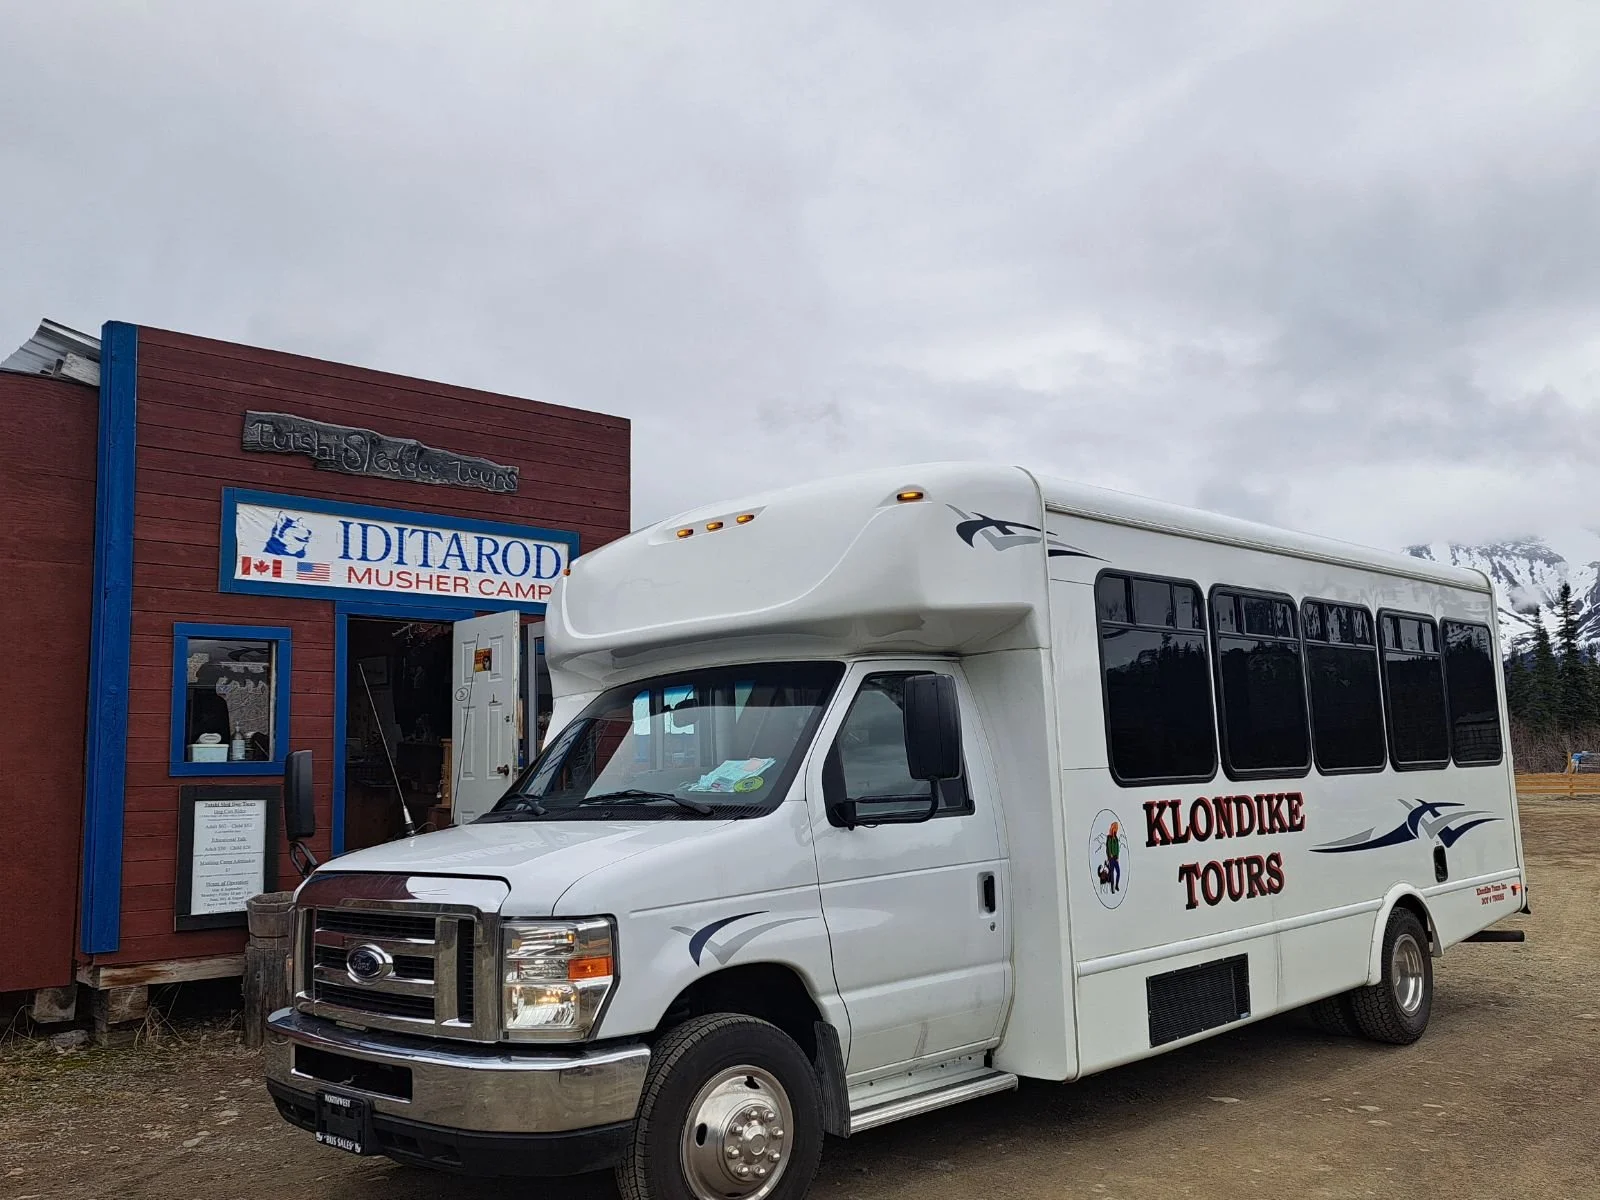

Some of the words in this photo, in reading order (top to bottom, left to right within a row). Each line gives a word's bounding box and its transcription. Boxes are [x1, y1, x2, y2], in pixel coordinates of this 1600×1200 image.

[338, 519, 562, 580] IDITAROD
[347, 566, 469, 594] MUSHER
[478, 578, 553, 600] CAMP
[1142, 791, 1306, 847] KLONDIKE
[1177, 851, 1285, 910] TOURS
[325, 1093, 351, 1108] NORTHWEST
